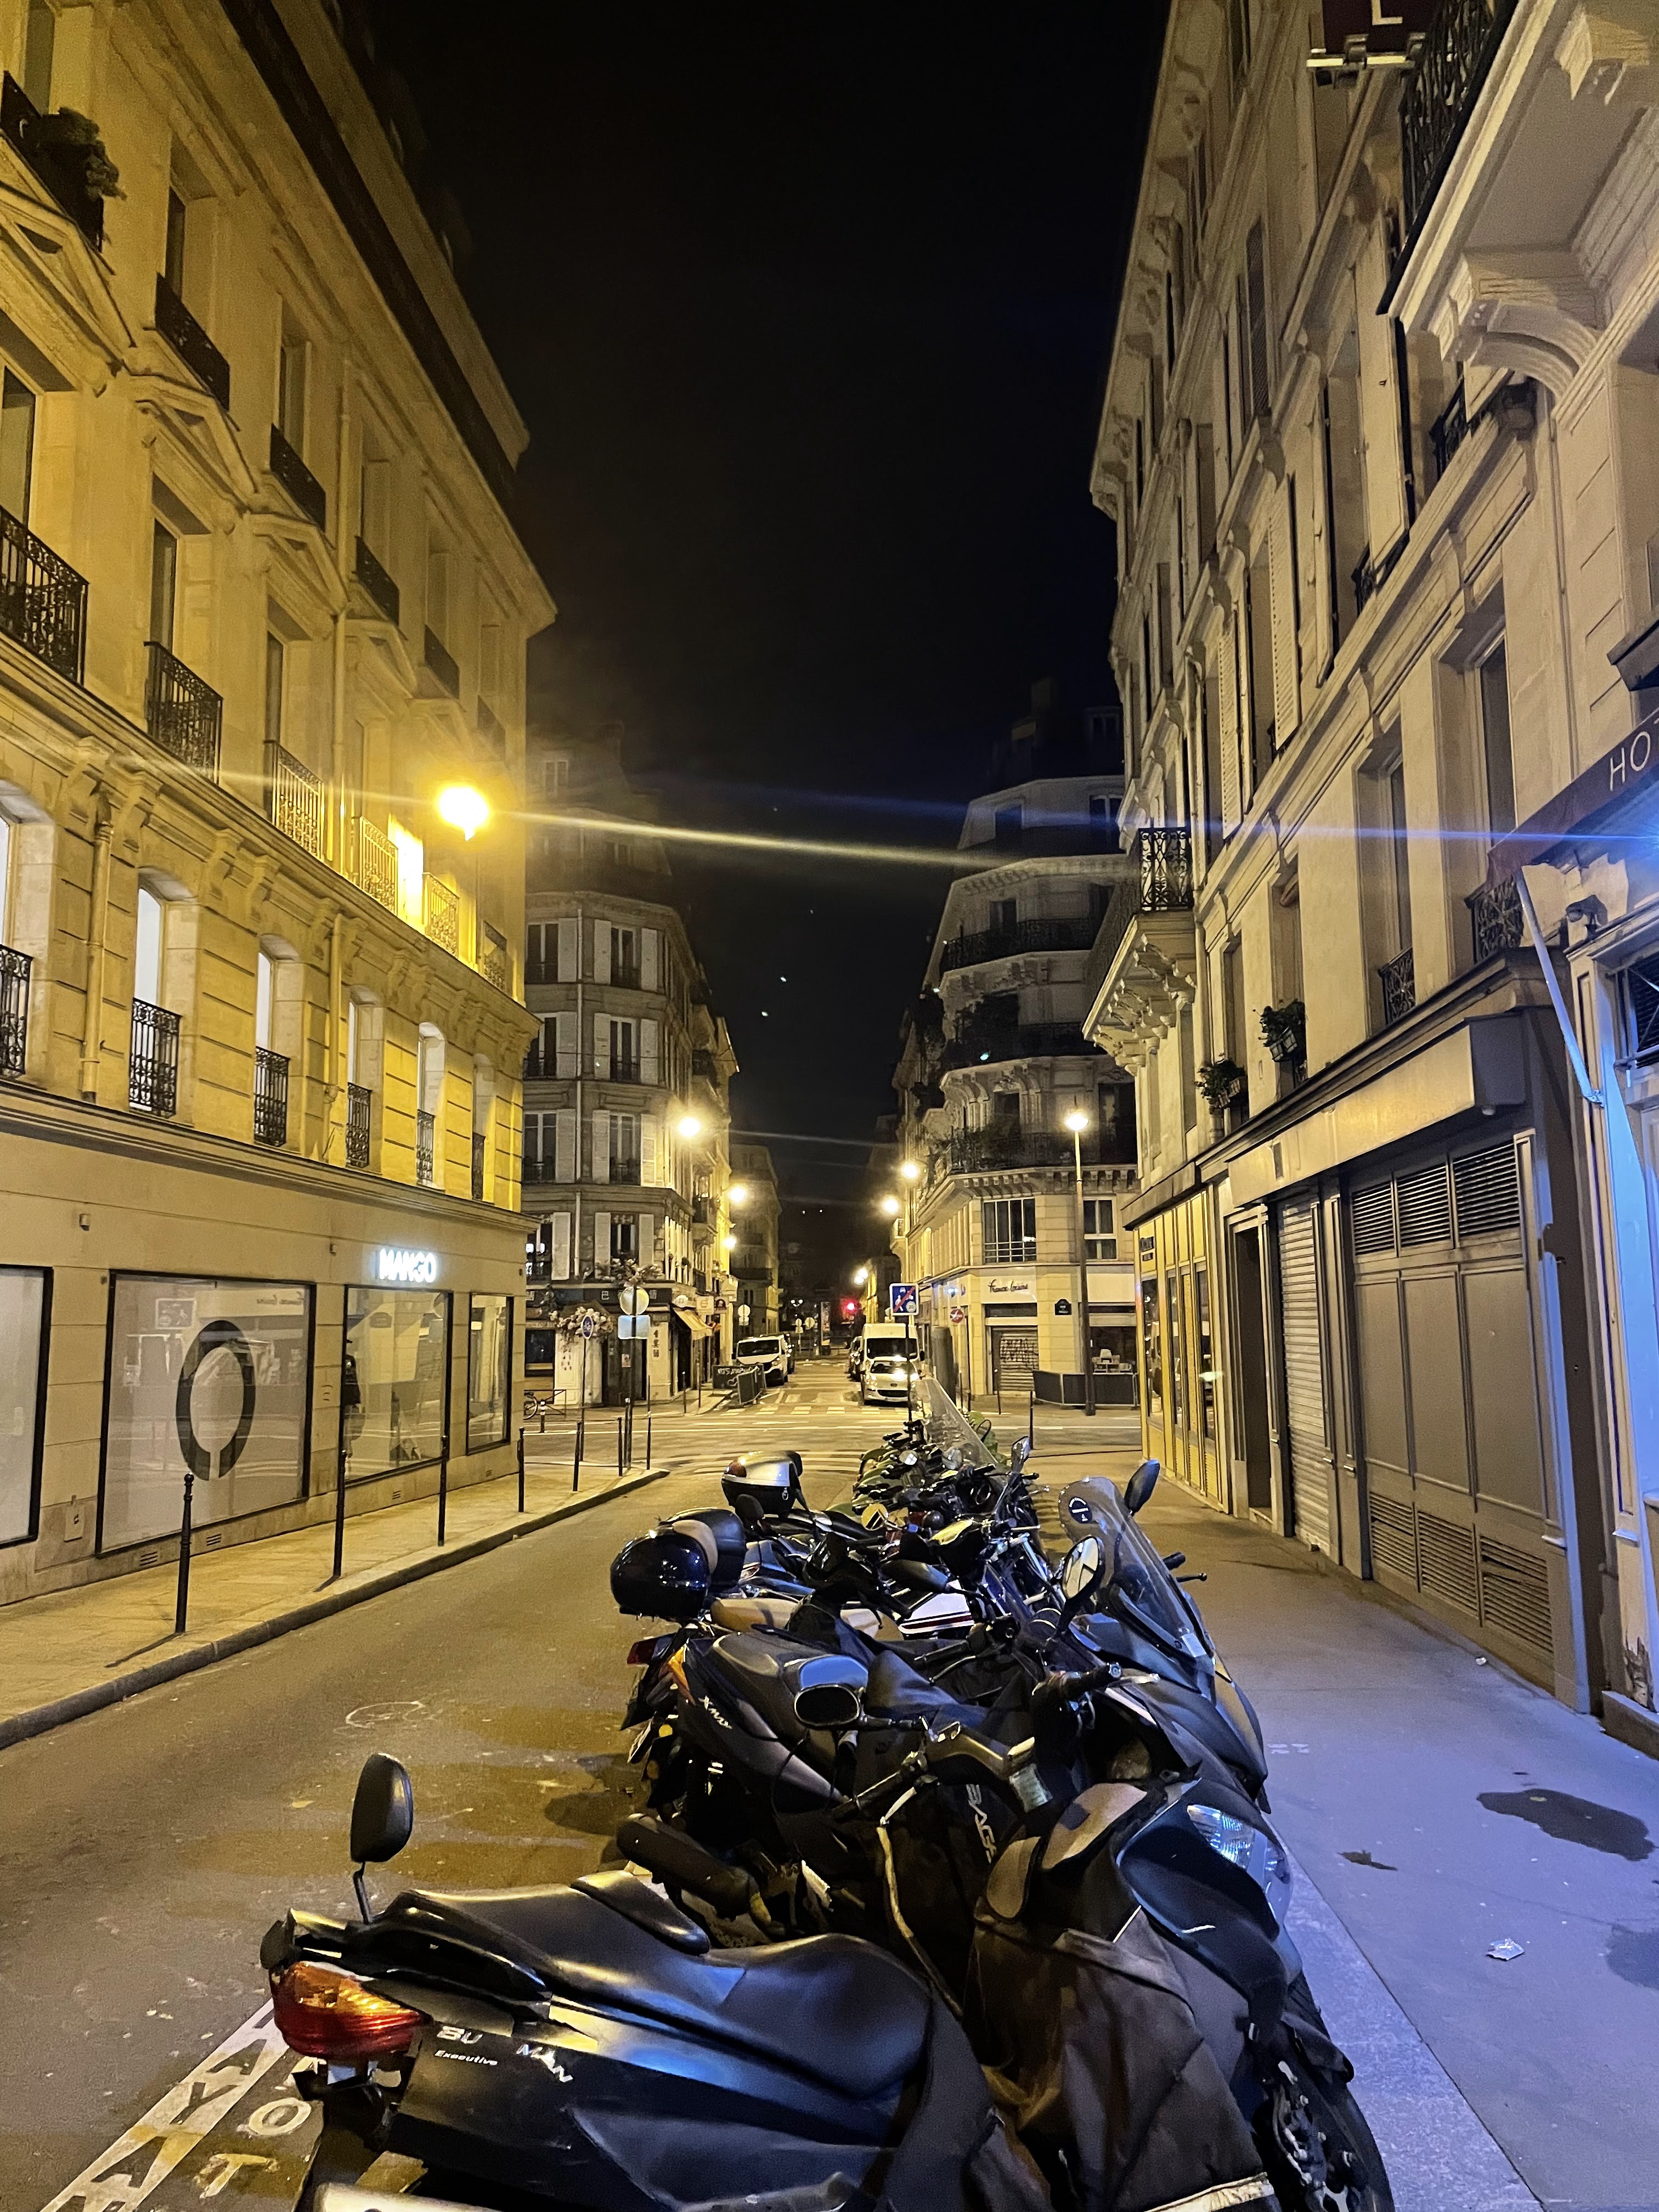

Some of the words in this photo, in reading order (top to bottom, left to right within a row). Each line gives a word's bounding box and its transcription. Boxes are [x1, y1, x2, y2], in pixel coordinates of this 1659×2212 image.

[1610, 717, 1659, 792] HO
[379, 1248, 436, 1283] MANGO
[435, 2050, 498, 2066] Executive
